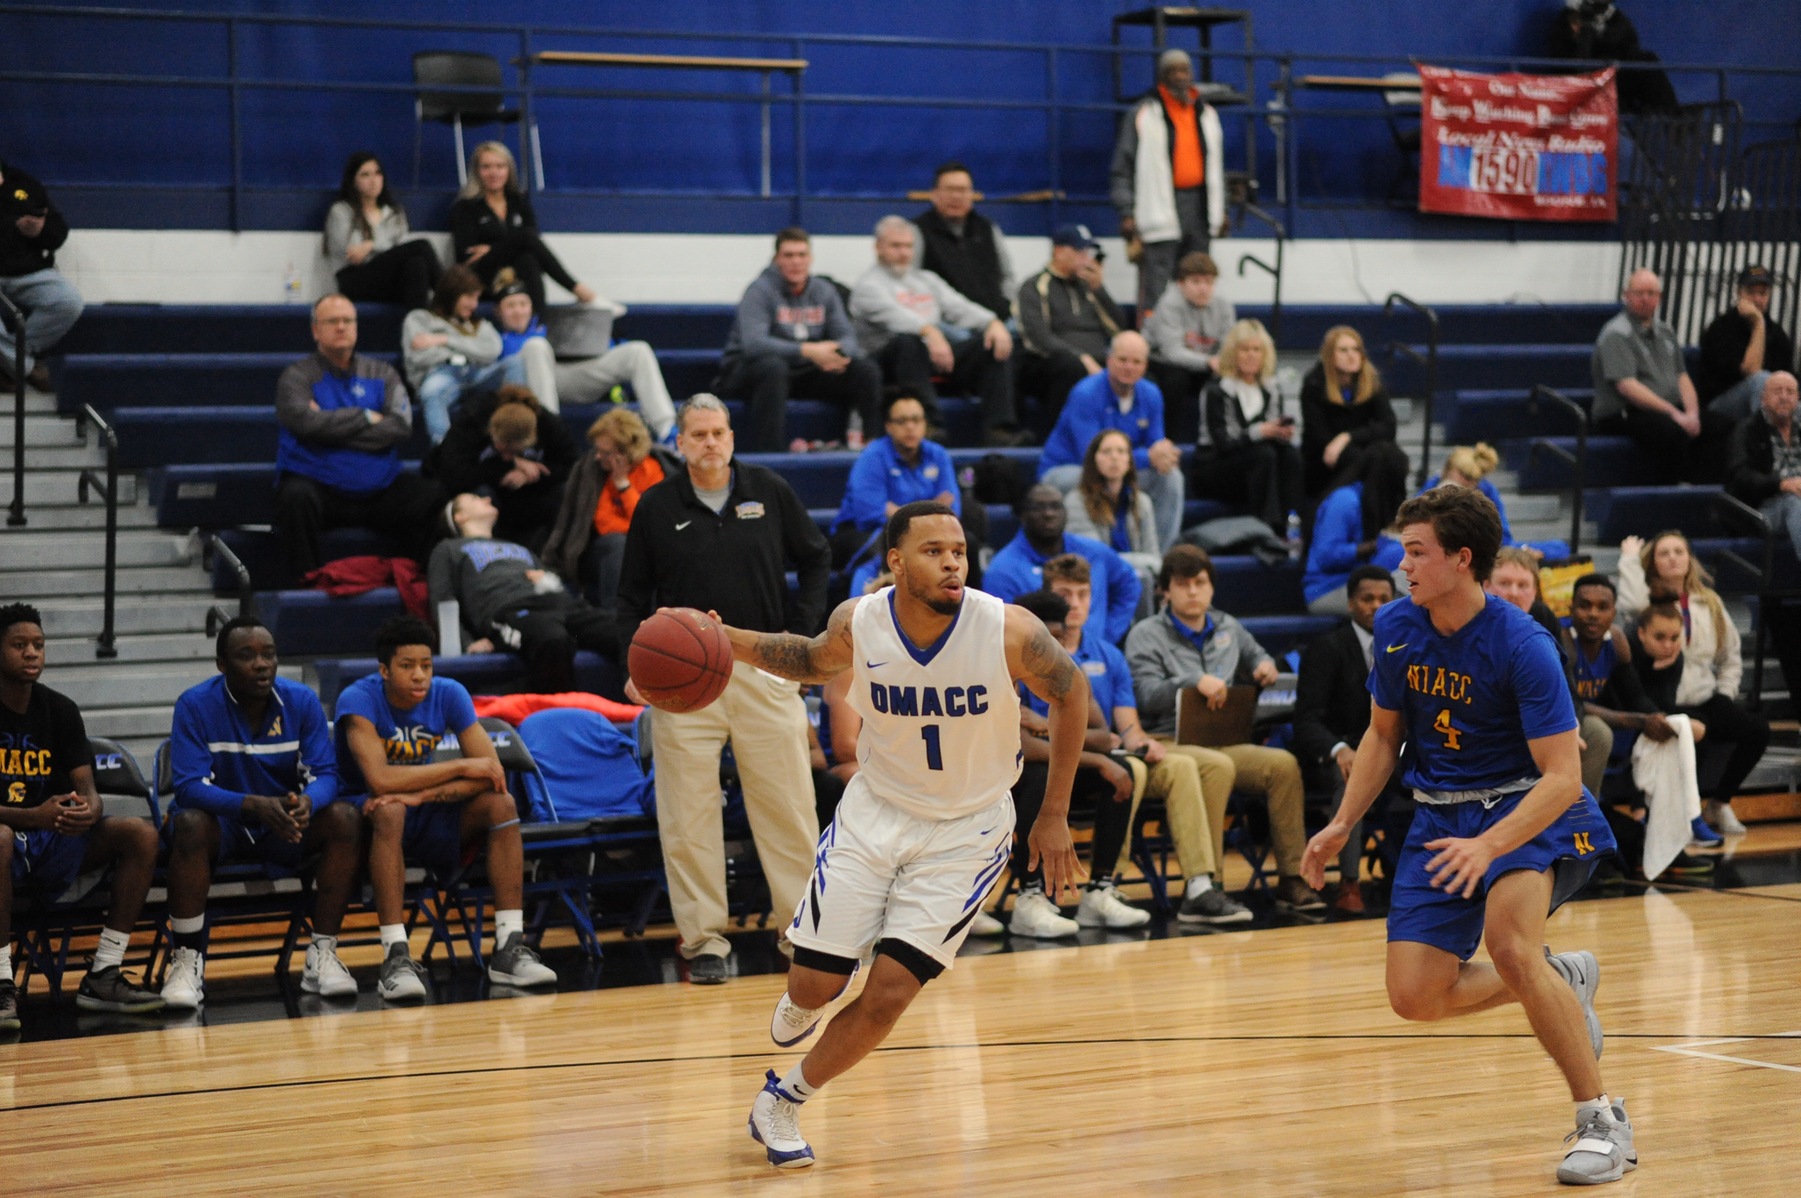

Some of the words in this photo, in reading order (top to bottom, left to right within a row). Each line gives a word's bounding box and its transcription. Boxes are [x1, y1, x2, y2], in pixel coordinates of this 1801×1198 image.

[1437, 125, 1496, 146] Local
[1548, 134, 1606, 154] Radio
[1474, 149, 1537, 191] 1590
[869, 681, 989, 717] DMACC
[1407, 665, 1472, 705] NIACC
[921, 724, 944, 771] 1
[1433, 709, 1462, 750] 4
[1573, 832, 1595, 855] N
